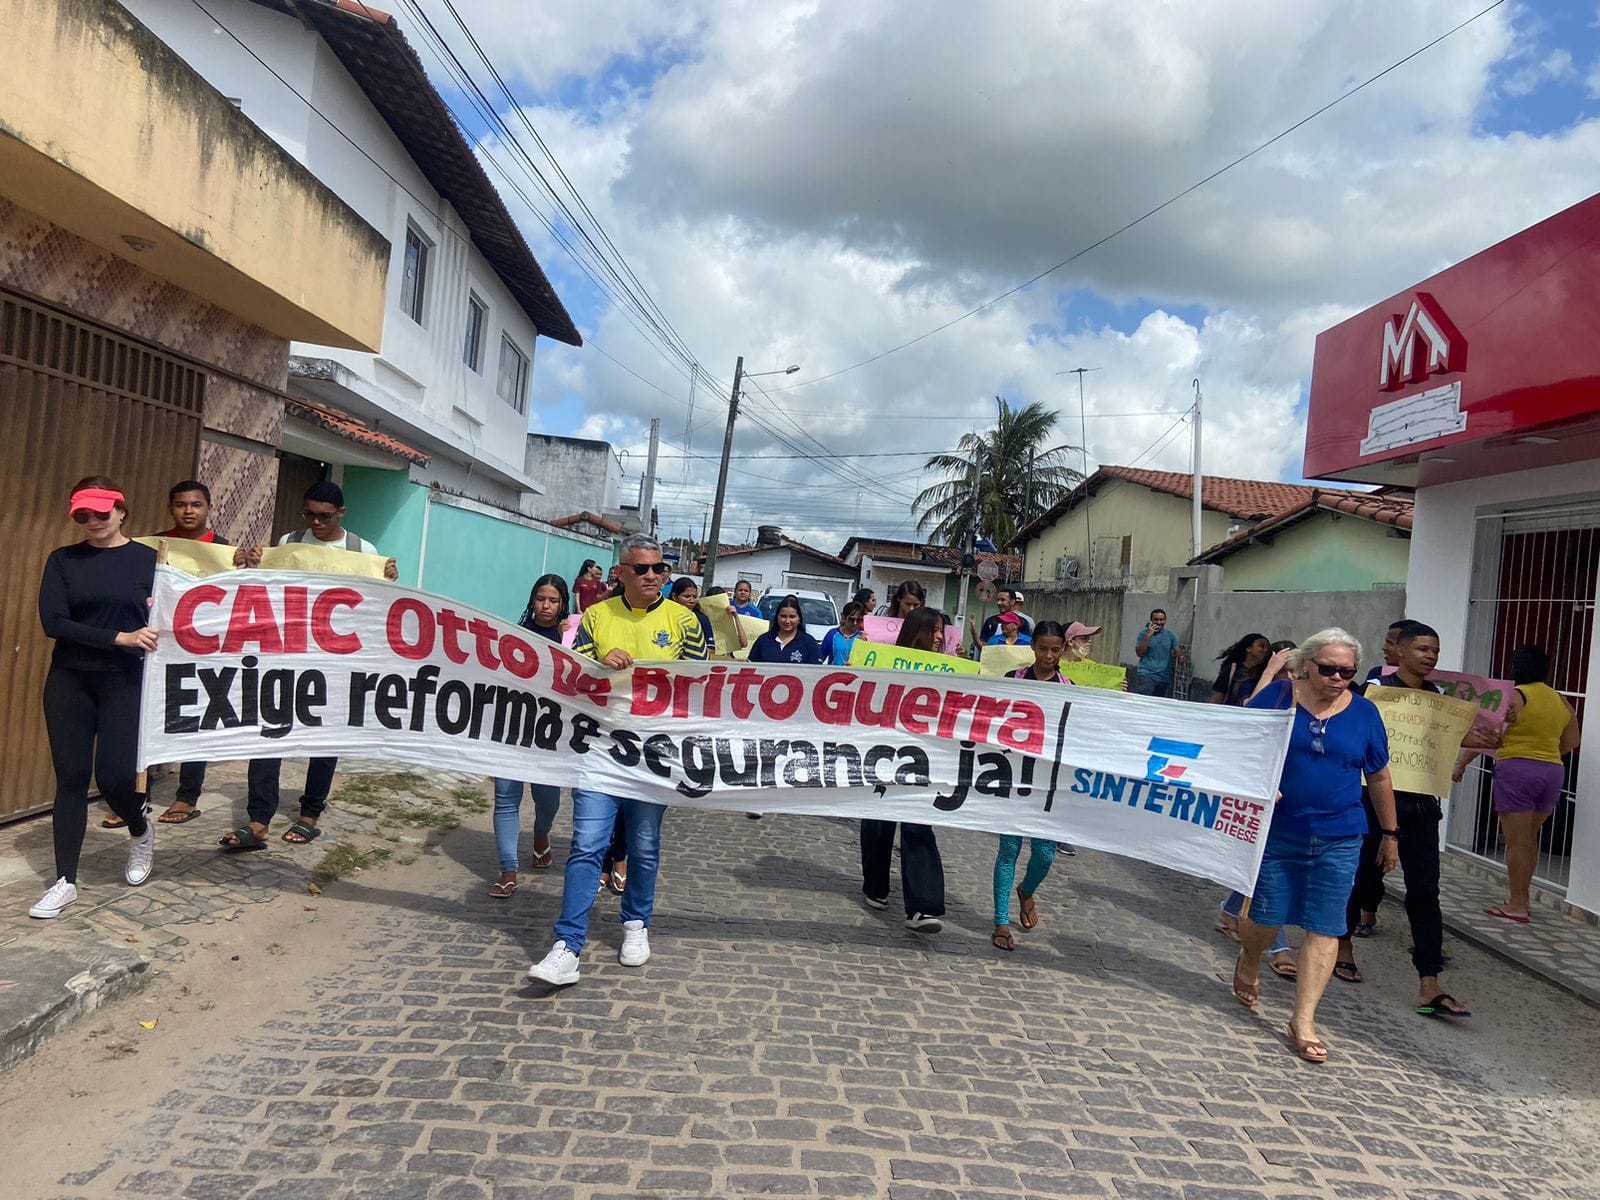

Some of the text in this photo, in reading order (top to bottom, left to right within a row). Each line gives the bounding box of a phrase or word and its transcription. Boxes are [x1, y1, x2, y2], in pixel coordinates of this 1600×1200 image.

[173, 584, 364, 656] CAIC
[386, 597, 540, 680] Otto
[812, 671, 1046, 755] Guerra
[864, 650, 877, 668] A
[164, 655, 1036, 811] Exige reforma e segurança já!
[1221, 796, 1265, 816] CUT
[1213, 820, 1258, 844] DIEESE
